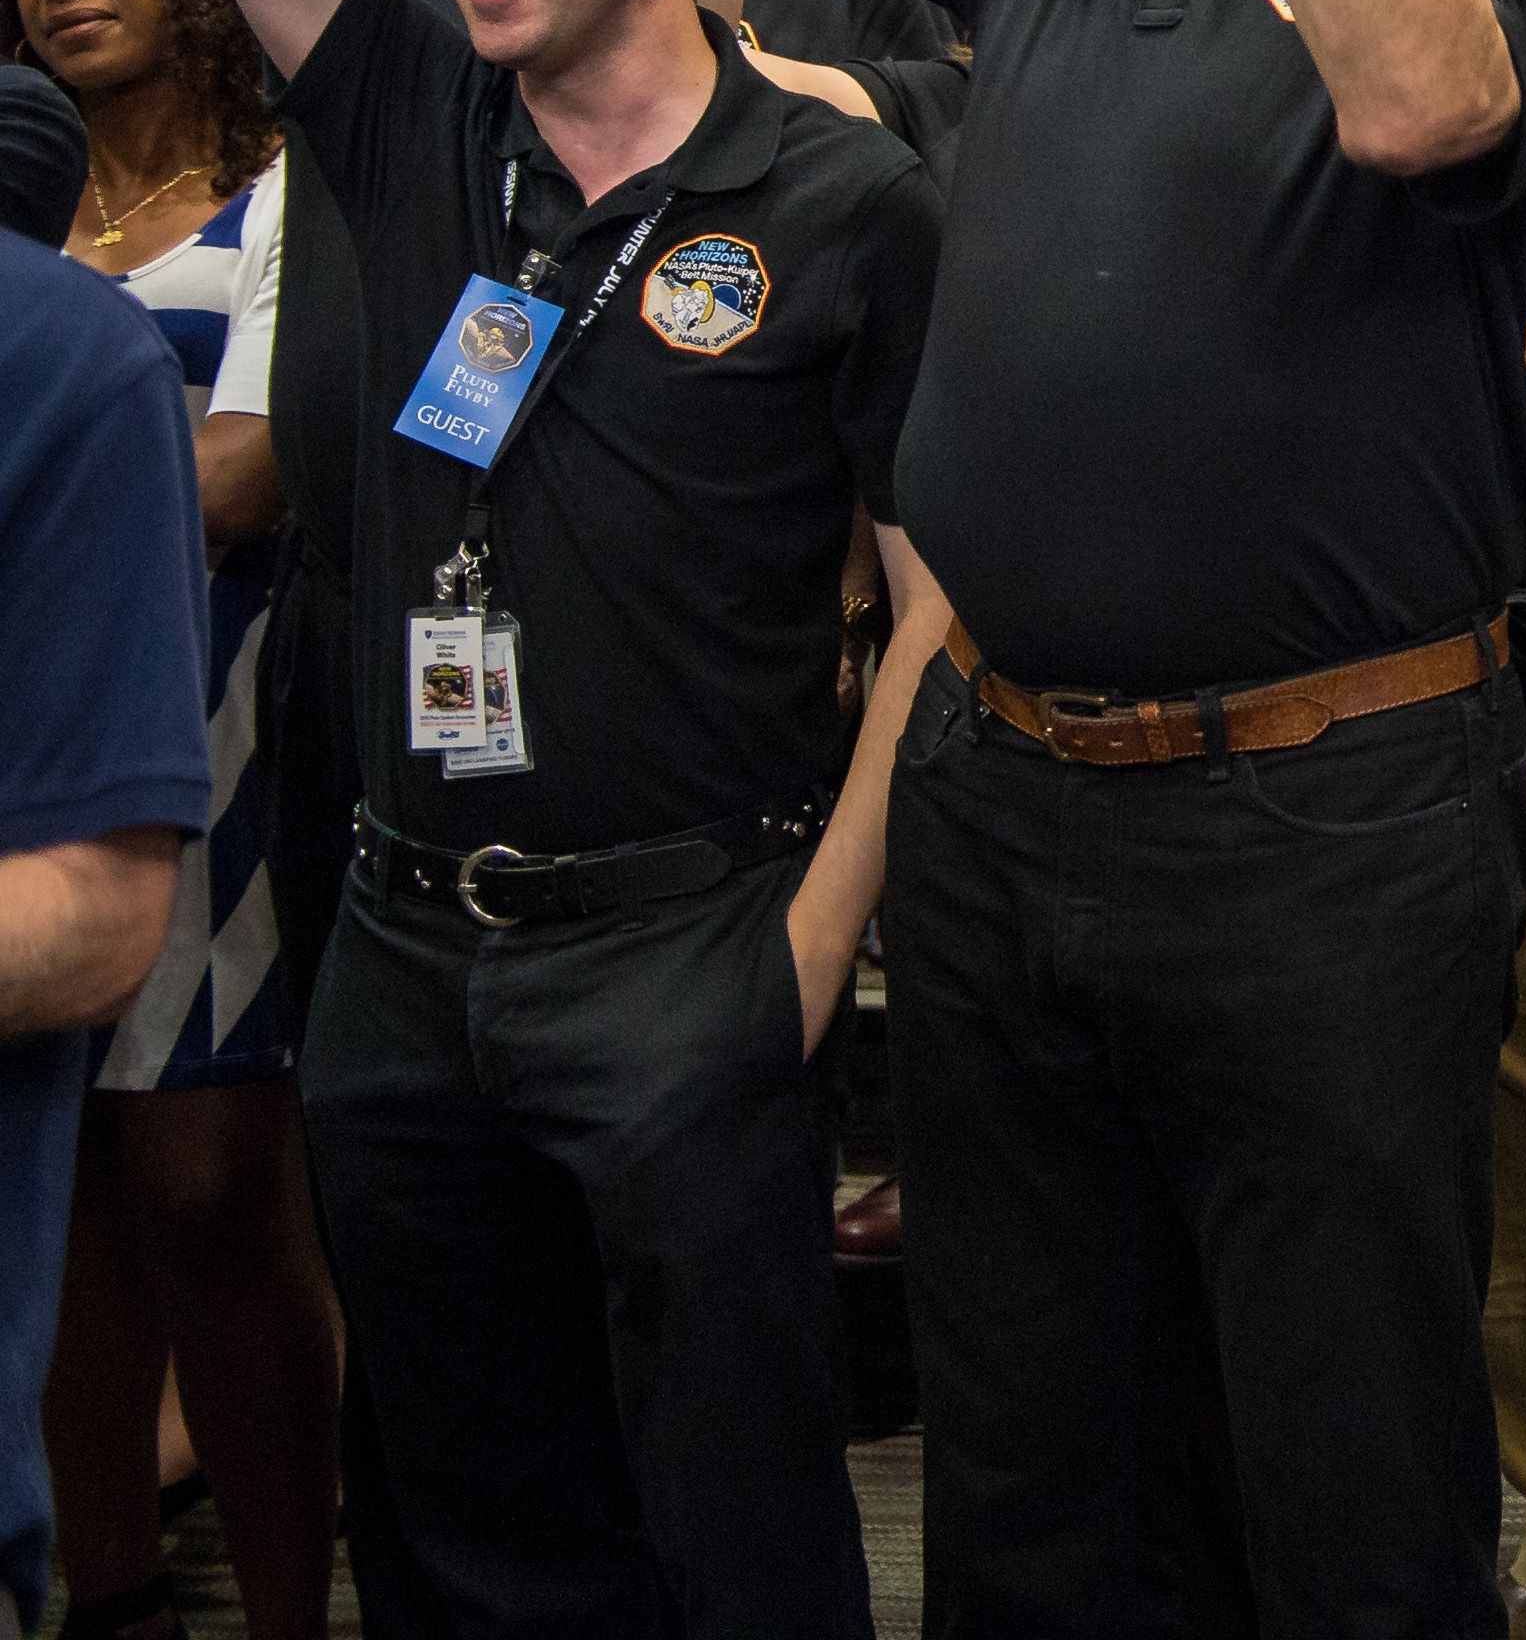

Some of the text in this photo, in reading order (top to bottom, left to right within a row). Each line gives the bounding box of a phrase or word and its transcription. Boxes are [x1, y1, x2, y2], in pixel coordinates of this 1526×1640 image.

[698, 241, 730, 252] NEW
[678, 251, 748, 264] HORIZONS
[701, 272, 739, 284] Mission
[593, 265, 622, 308] JULY
[677, 334, 709, 347] NASA
[417, 405, 490, 445] GUEST
